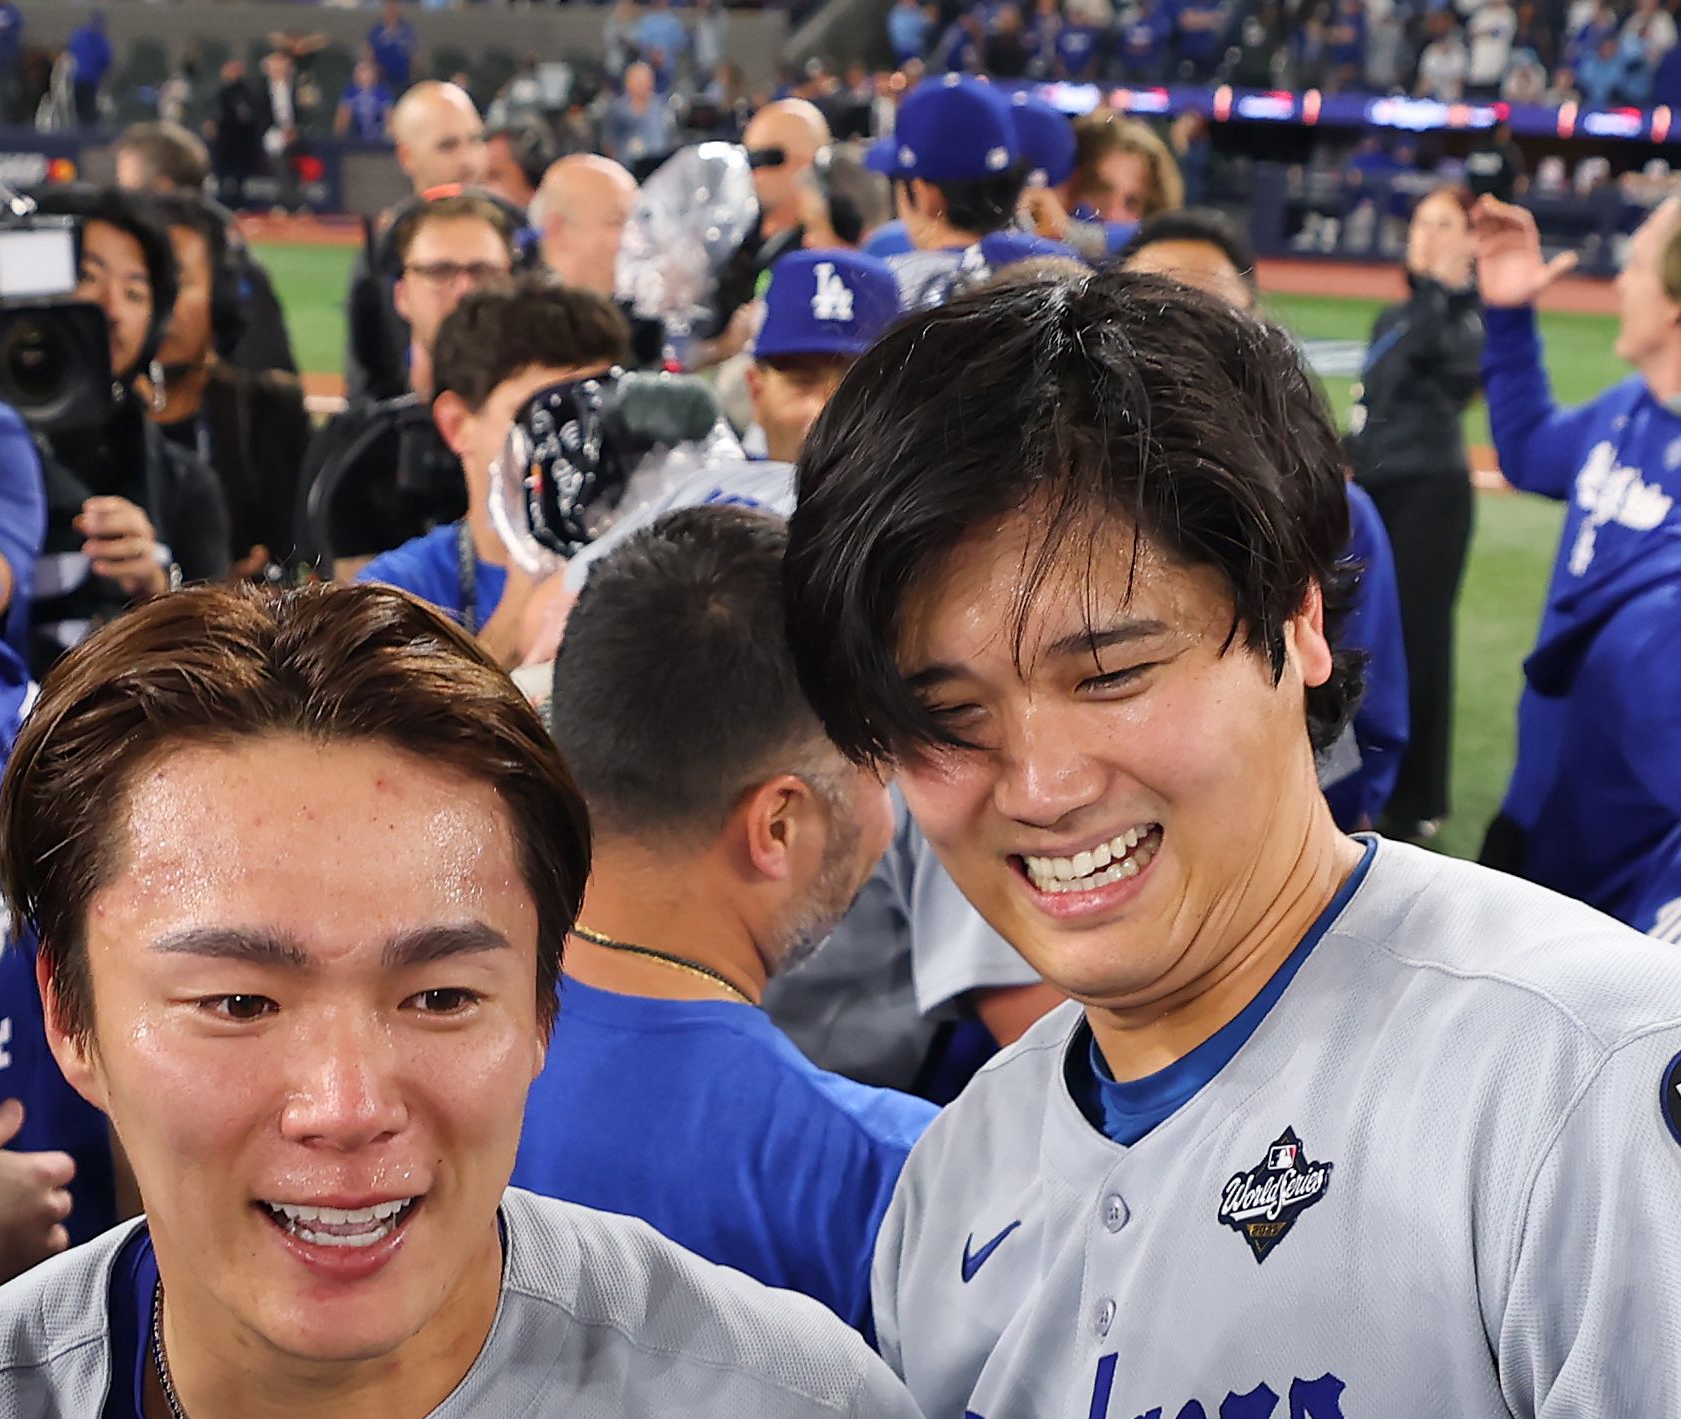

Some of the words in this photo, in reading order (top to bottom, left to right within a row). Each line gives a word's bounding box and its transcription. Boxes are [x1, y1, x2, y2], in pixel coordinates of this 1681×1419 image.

[810, 262, 854, 322] LA
[1221, 1174, 1284, 1216] World
[1267, 1167, 1325, 1221] Series
